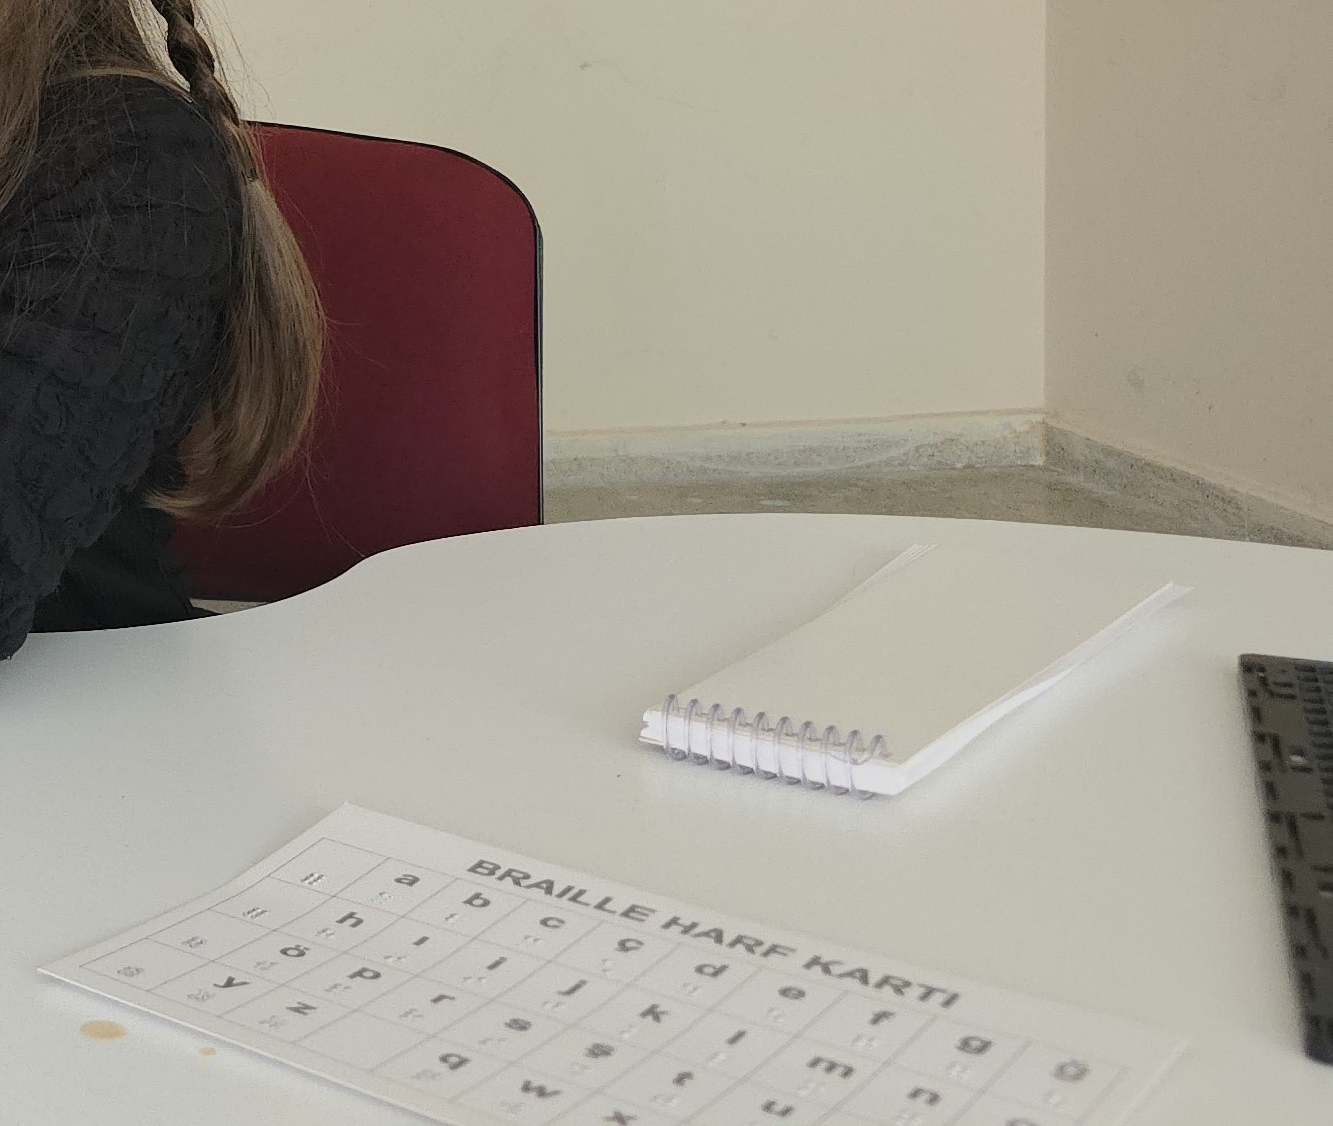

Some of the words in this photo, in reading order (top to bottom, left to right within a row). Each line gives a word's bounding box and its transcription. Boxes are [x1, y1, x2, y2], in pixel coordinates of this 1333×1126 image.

[335, 911, 364, 929] h
[557, 979, 588, 997] j
[639, 1003, 668, 1024] k
[806, 1056, 855, 1079] m
[906, 1087, 941, 1107] n
[394, 873, 421, 888] a
[462, 892, 492, 909] b
[539, 916, 566, 930] c
[694, 963, 730, 979] d
[777, 985, 807, 1001] e
[869, 1010, 895, 1026] f
[956, 1035, 993, 1056] g
[466, 858, 658, 923] BRAILLE
[660, 915, 797, 958] HARF
[802, 955, 960, 1009] KARTI
[213, 975, 250, 989] y
[285, 1001, 318, 1017] z
[438, 1052, 471, 1072] q
[520, 1080, 561, 1099] w
[604, 1110, 637, 1126] x
[279, 944, 310, 958] ö
[347, 966, 382, 981] p
[430, 993, 456, 1004] r
[504, 1017, 533, 1032] s
[761, 1100, 795, 1118] u
